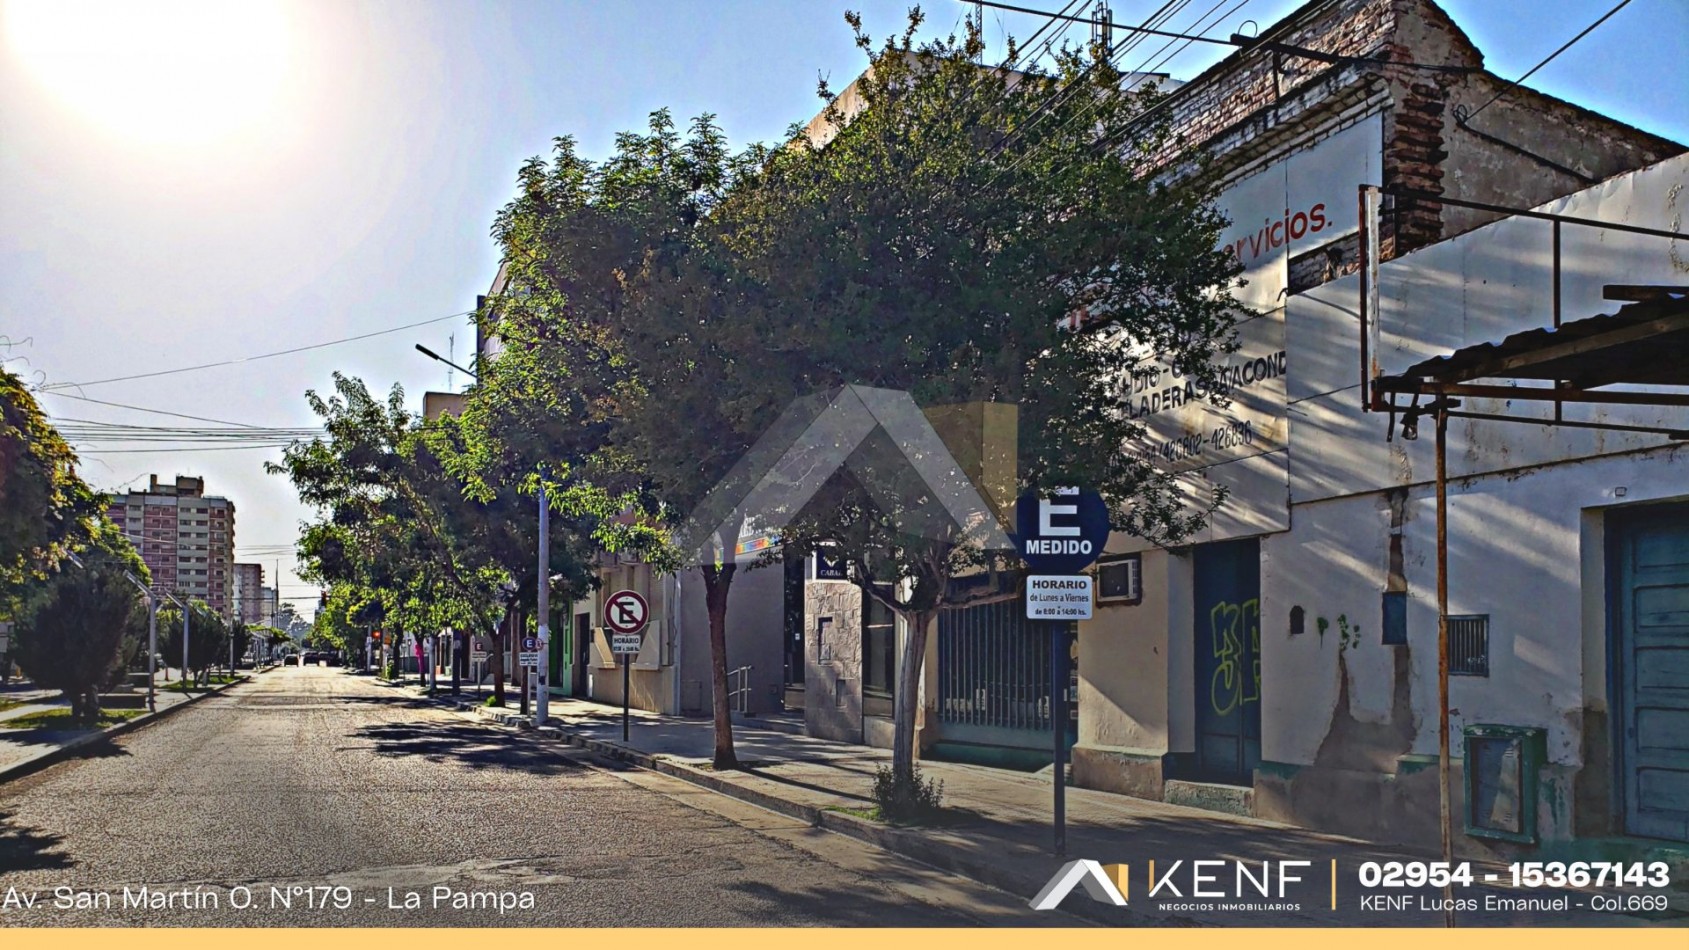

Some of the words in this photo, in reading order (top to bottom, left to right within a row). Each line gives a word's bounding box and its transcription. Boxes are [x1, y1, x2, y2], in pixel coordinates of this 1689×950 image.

[1222, 203, 1332, 258] ervicios.
[1039, 485, 1081, 536] E
[1026, 540, 1093, 555] MEDIDO
[1032, 580, 1087, 589] HORARIO
[1030, 594, 1038, 602] de
[1039, 593, 1059, 602] Lunes
[1065, 593, 1089, 603] Viernes
[527, 640, 533, 648] E
